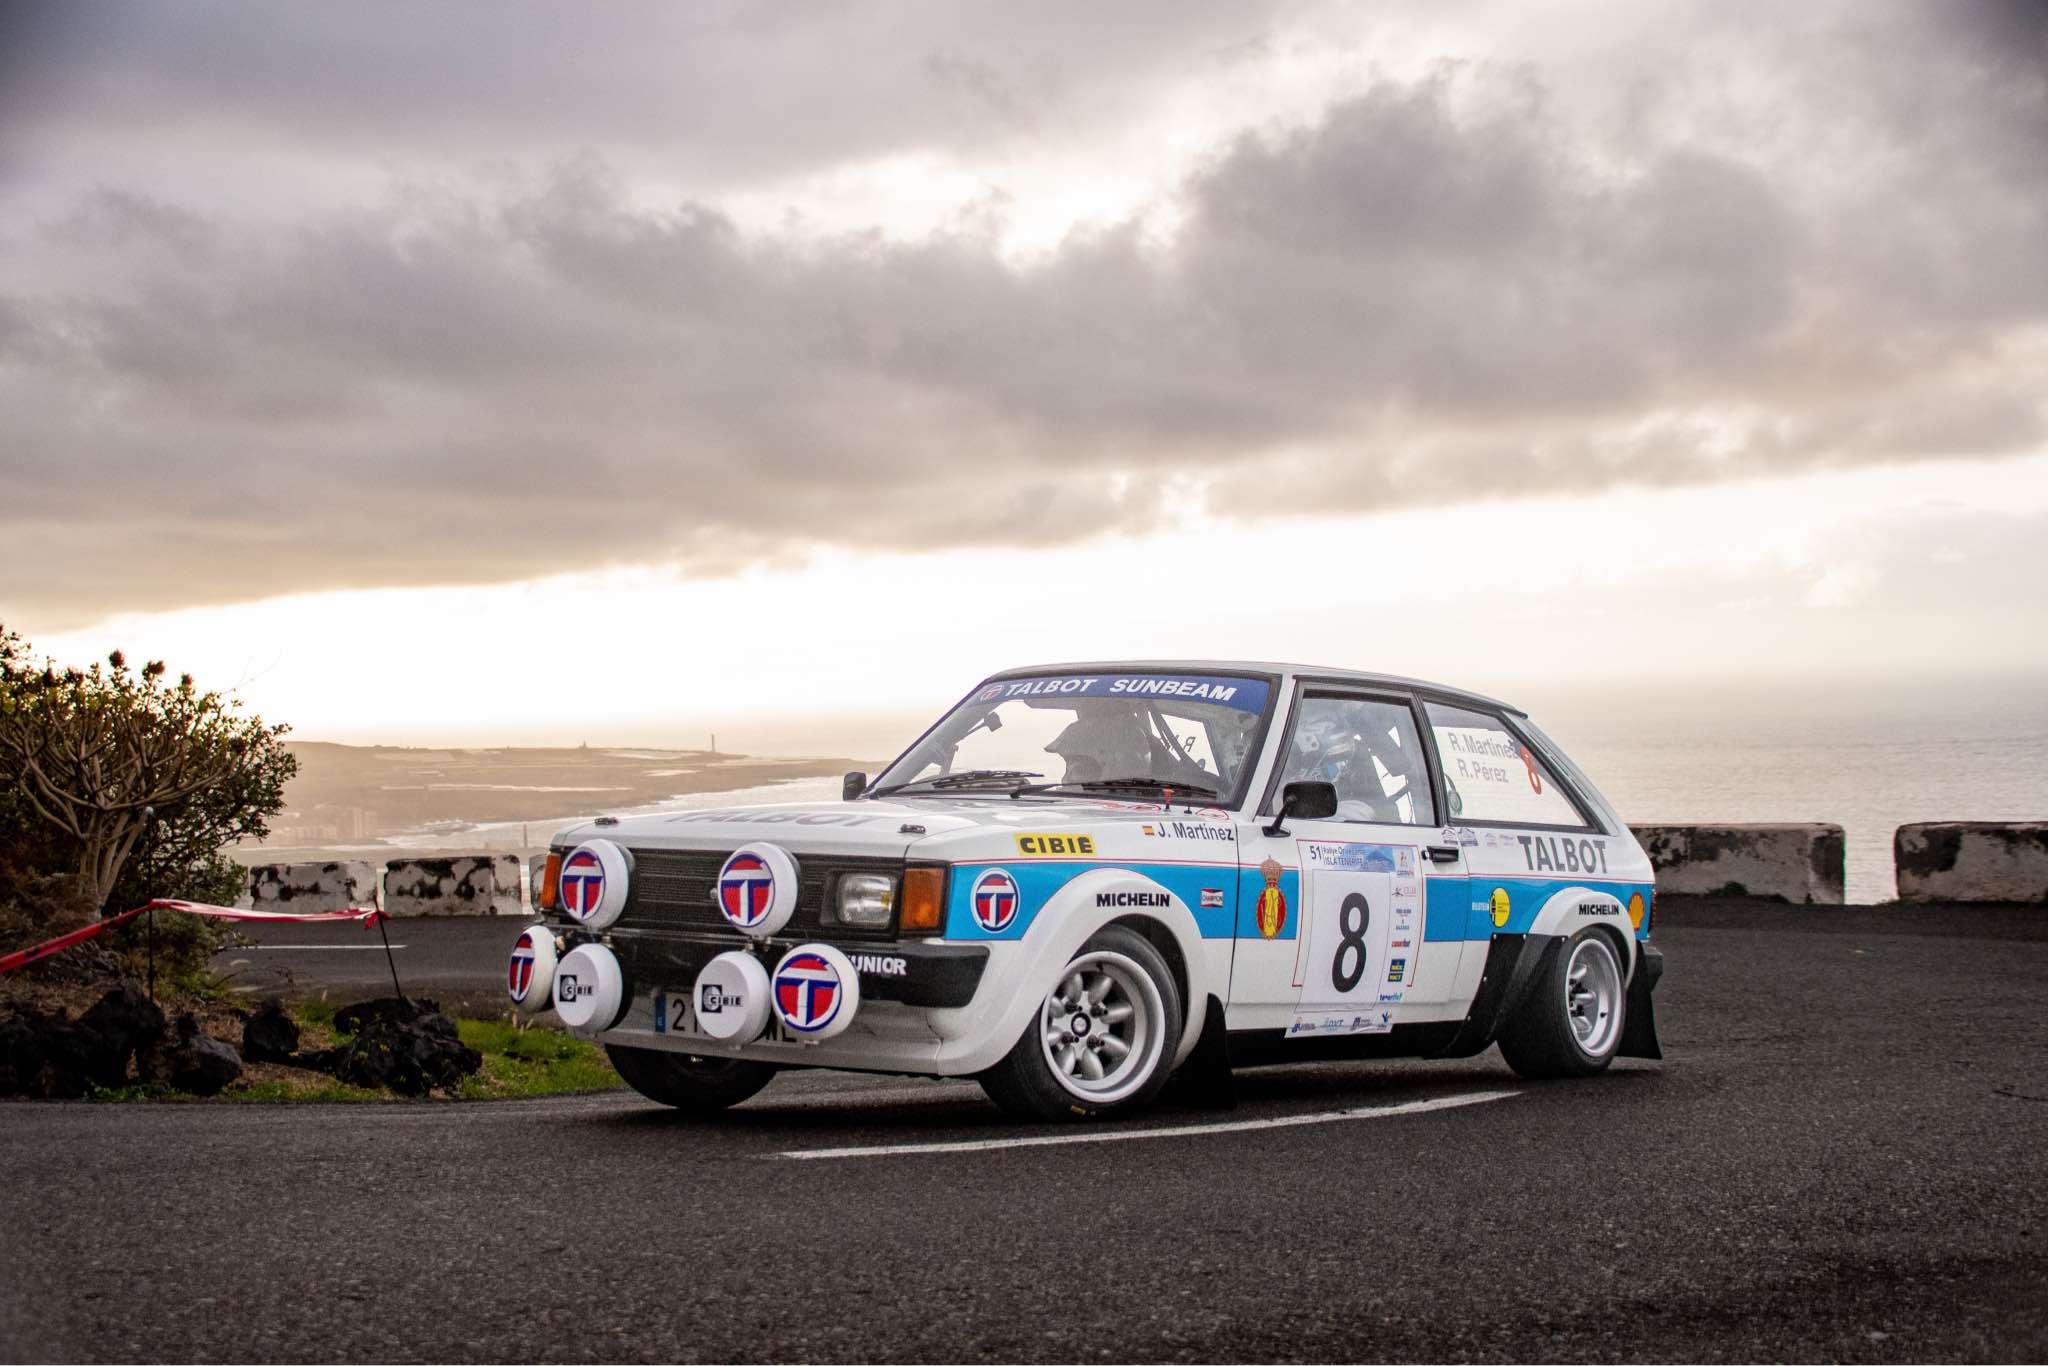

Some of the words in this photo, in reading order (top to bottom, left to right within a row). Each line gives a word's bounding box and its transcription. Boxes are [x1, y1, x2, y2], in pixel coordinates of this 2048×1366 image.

[1005, 679, 1099, 697] TALBOT
[1109, 678, 1238, 701] SUNBEAM
[1019, 836, 1093, 854] CIBIE
[1516, 835, 1608, 874] TALBOT
[1096, 893, 1170, 908] MICHELIN
[1578, 903, 1620, 916] MICHELIN
[1332, 892, 1370, 993] 8
[848, 954, 907, 976] UNIOR
